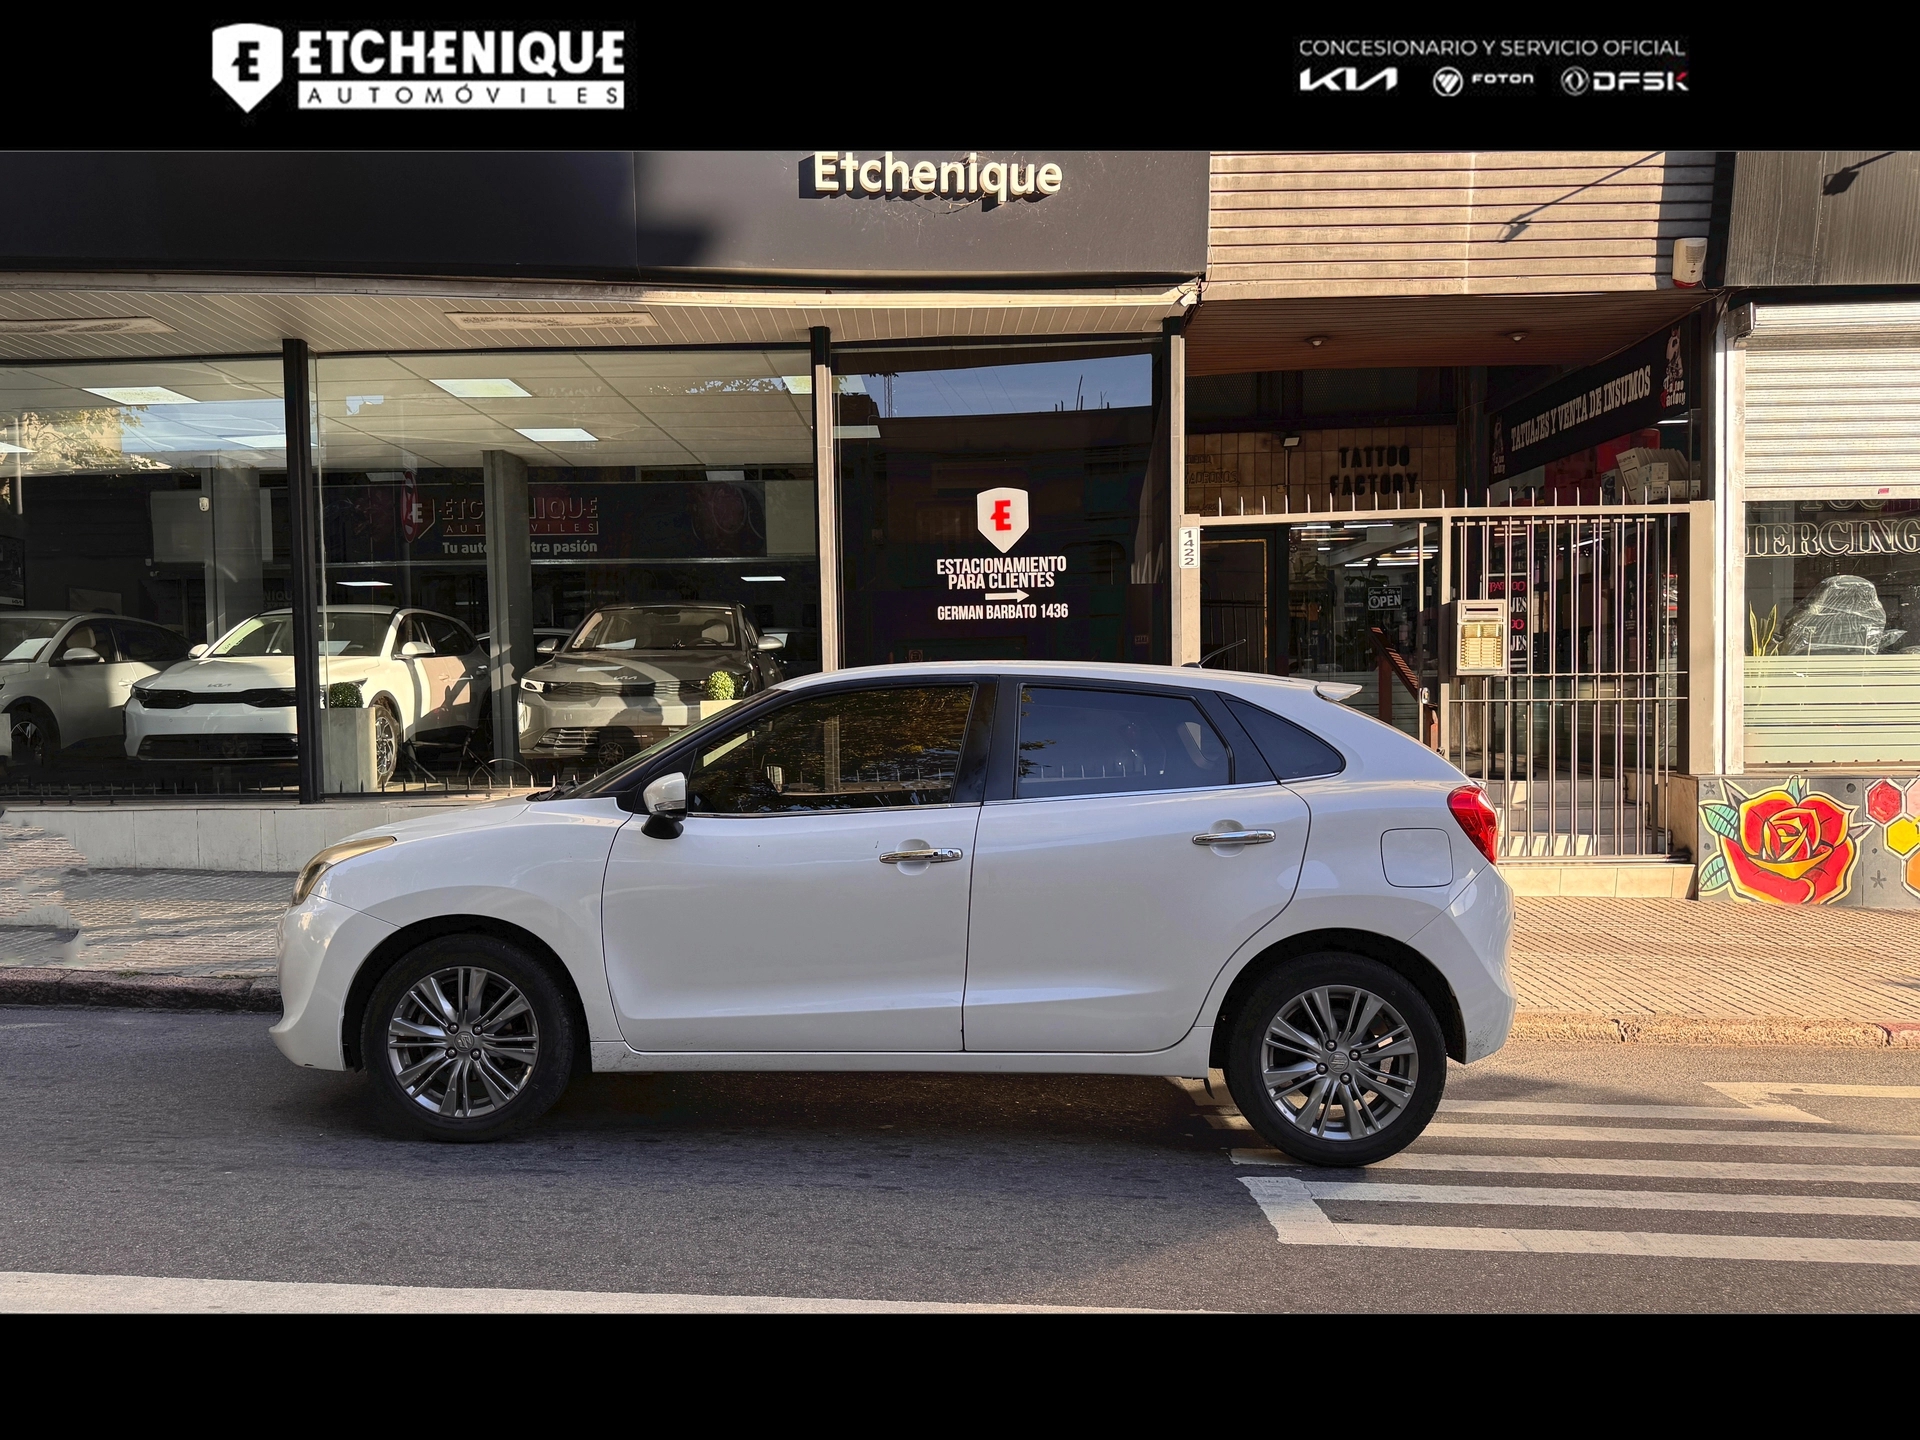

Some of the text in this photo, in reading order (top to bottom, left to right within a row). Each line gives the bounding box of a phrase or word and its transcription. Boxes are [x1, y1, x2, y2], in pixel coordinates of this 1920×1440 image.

[813, 151, 1063, 205] Etchenique
[1511, 365, 1651, 452] TATUAJES Y VENTA DE INSUMOS
[1339, 445, 1411, 468] TATTOO
[1330, 471, 1418, 497] FACTORY
[439, 497, 598, 520] ETCIQUE
[445, 523, 594, 533] AUTVILES
[1745, 519, 1920, 557] IERCING
[442, 542, 458, 554] Tu
[553, 540, 598, 556] pasión
[1183, 530, 1195, 566] 1422
[936, 555, 1067, 575] ESTACIONAMIENTO
[948, 572, 1055, 590] PARA CLIENTES
[937, 603, 1069, 621] GERMAN BARBATO 1436
[1368, 594, 1401, 608] OPEN
